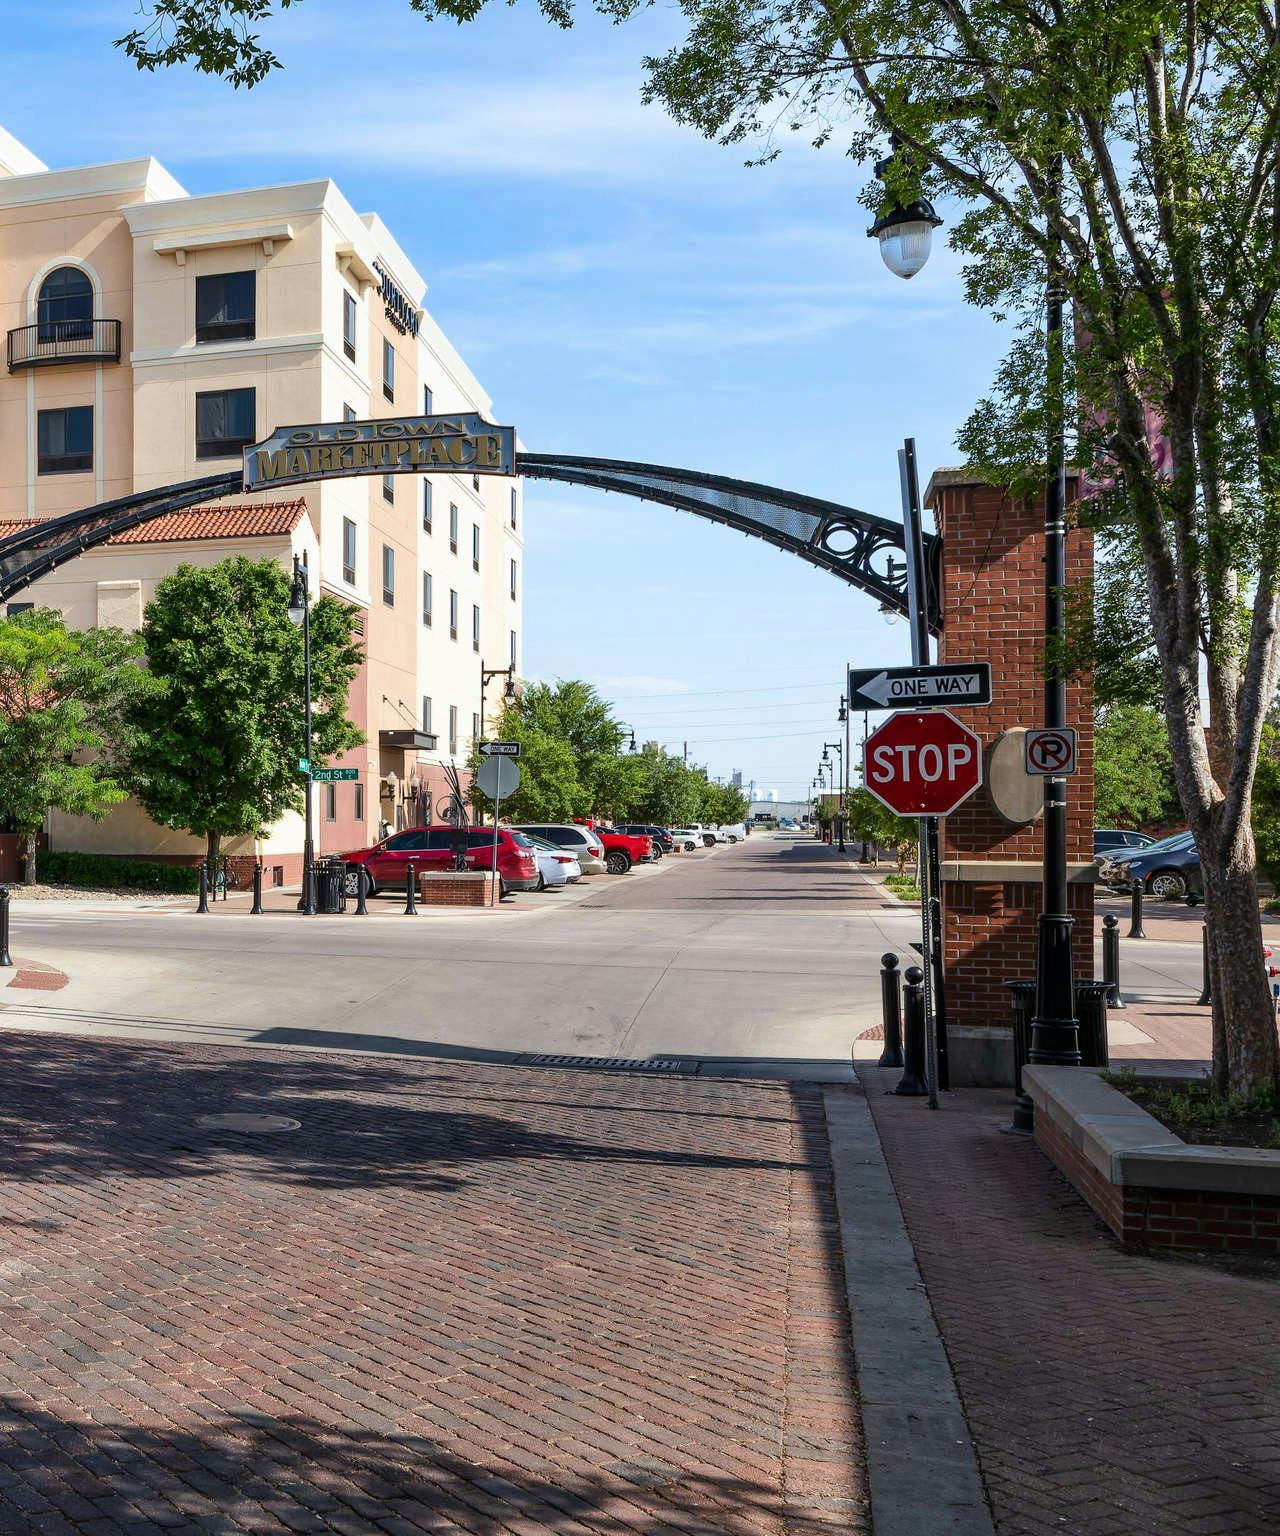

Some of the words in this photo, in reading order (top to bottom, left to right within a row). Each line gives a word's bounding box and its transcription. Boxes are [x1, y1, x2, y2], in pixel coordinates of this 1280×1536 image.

[289, 429, 359, 444] OLD
[356, 418, 465, 439] TOWN
[254, 433, 503, 482] MARKETPLACE
[891, 678, 929, 696] ONE
[935, 675, 975, 693] WAY
[315, 770, 331, 779] 2nd
[333, 770, 343, 779] St
[871, 743, 972, 784] STOP
